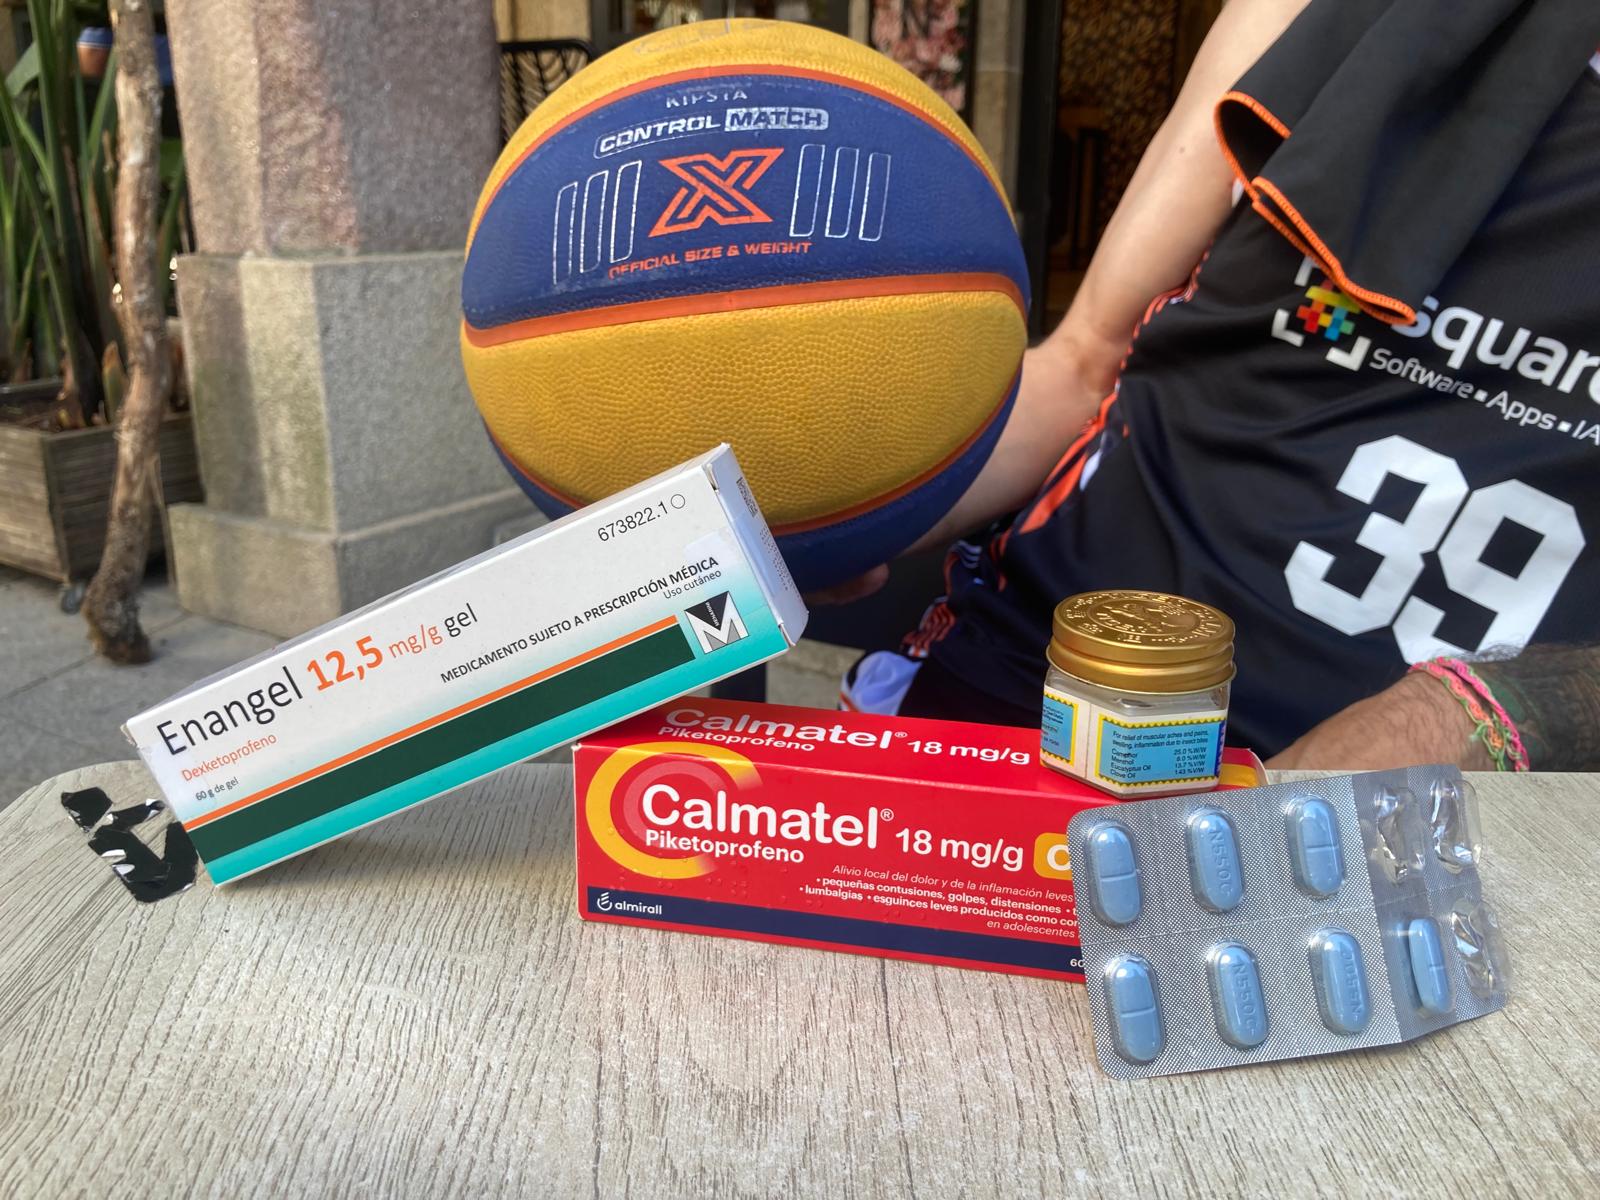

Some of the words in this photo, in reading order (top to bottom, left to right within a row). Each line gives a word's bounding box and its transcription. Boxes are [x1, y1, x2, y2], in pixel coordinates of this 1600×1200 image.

[600, 115, 721, 153] CONTROL
[727, 108, 823, 128] MATCH
[608, 253, 680, 280] OFFICIAL
[684, 246, 723, 263] SIZE
[727, 244, 740, 257] &
[745, 242, 812, 254] WEIGHT
[1370, 348, 1475, 399] Software
[1485, 390, 1557, 431] Apps
[597, 501, 669, 542] 673822.1
[1283, 434, 1586, 666] 39
[663, 587, 682, 599] Uso
[684, 570, 721, 591] cutáneo
[441, 639, 528, 683] MEDICAMENTO
[529, 620, 571, 645] SUJETO
[574, 615, 584, 626] A
[584, 578, 669, 622] PRESCRIPCIÓN
[669, 557, 719, 585] MÉDICA
[156, 666, 303, 756] Enangel
[307, 635, 383, 691] 12,5
[388, 624, 443, 658] mg/g
[444, 603, 477, 637] gel
[182, 734, 277, 781] Dexketoprofeno
[658, 726, 815, 751] Piketoprofeno
[907, 740, 942, 755] 18
[950, 745, 1030, 765] mg/g
[195, 790, 207, 801] 60
[208, 787, 215, 798] g
[215, 782, 225, 793] de
[226, 777, 239, 791] gel
[645, 829, 804, 863] Piketoprofeno
[895, 827, 932, 855] 18
[940, 838, 1023, 872] mg/g
[822, 876, 875, 892] pequeñas
[876, 882, 946, 900] contusiones,
[947, 890, 988, 907] golpes,
[990, 894, 1062, 914] distensiones
[833, 865, 861, 877] Alivio
[864, 867, 889, 880] local
[891, 870, 908, 882] del
[910, 873, 939, 886] dolor
[940, 879, 948, 888] y
[950, 878, 964, 889] de
[967, 880, 977, 891] la
[979, 881, 1043, 898] inflamación
[1045, 889, 1074, 902] leves
[614, 901, 662, 915] almirall
[805, 886, 863, 901] lumbalgias
[873, 894, 929, 910] esguinces
[930, 899, 959, 912] leves
[960, 904, 1024, 922] producidos
[1025, 913, 1056, 925] como
[987, 920, 1001, 930] en
[1002, 921, 1075, 938] adolescentes
